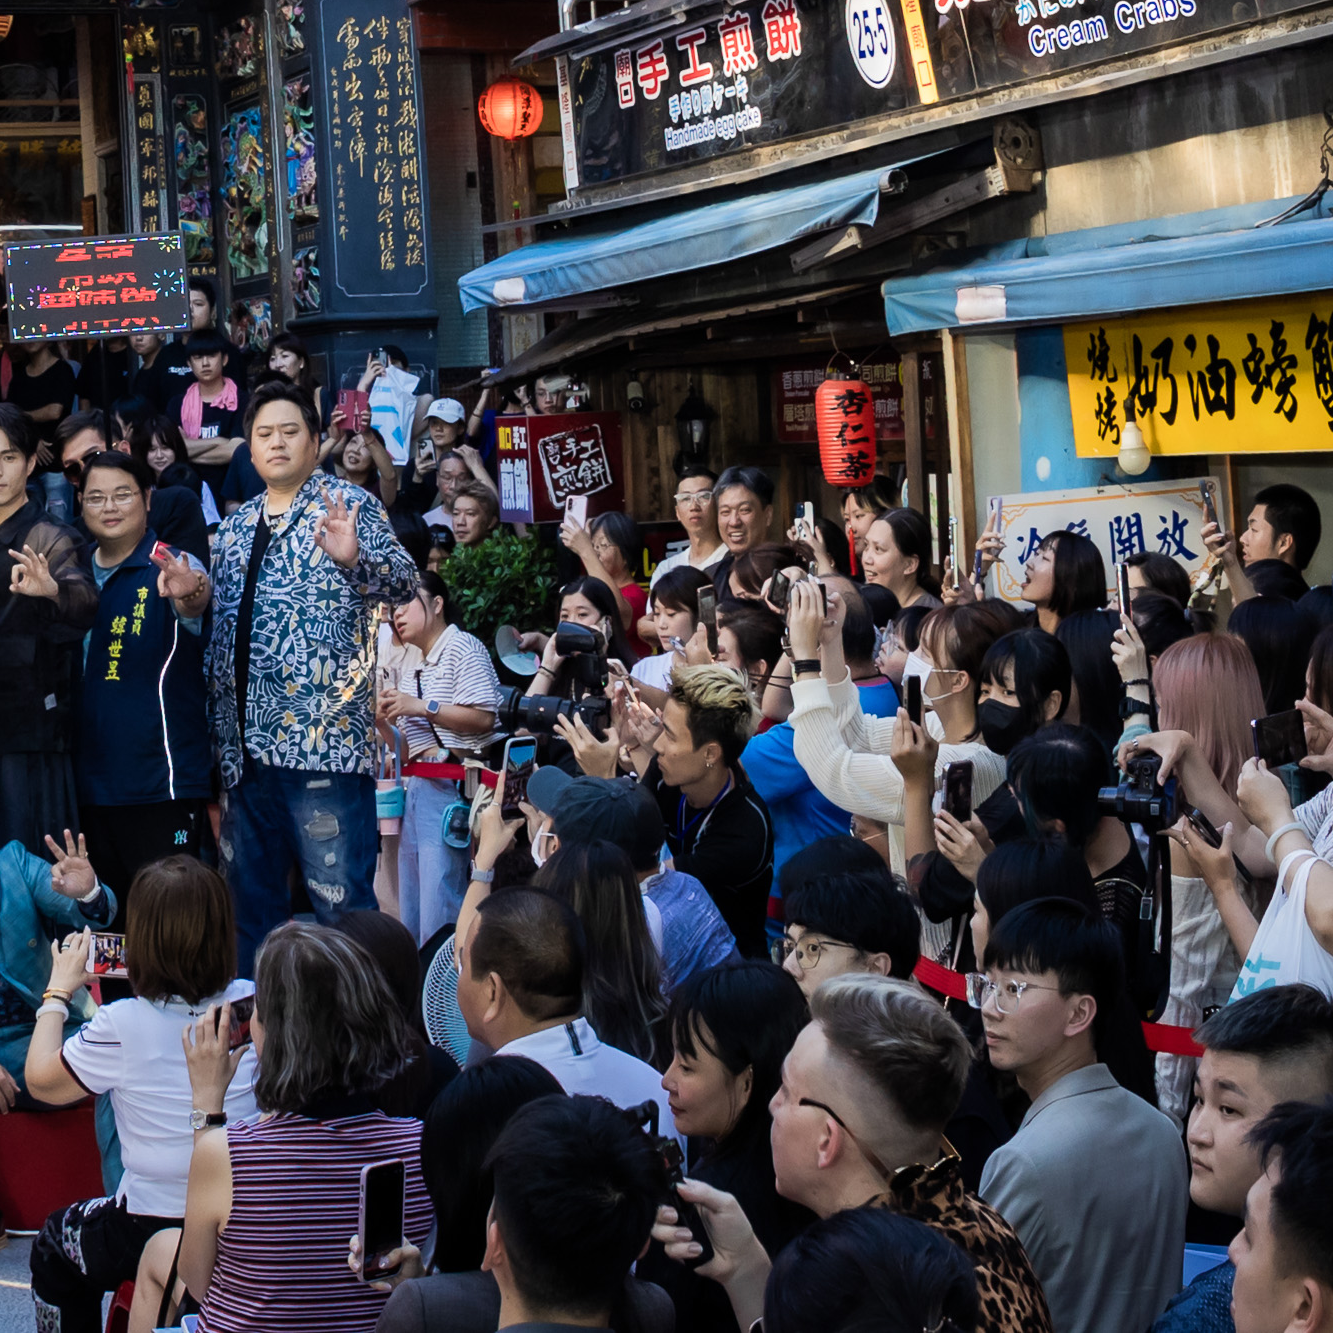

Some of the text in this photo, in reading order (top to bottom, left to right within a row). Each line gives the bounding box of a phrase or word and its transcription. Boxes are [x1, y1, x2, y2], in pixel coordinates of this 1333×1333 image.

[1027, 15, 1108, 57] Cream
[615, 48, 636, 109] 廟口
[668, 74, 749, 124] 手作り卵ケーキ
[664, 104, 763, 152] Handmade egg cake
[1087, 326, 1121, 446] 燒烤
[832, 389, 872, 481] 杏仁茶
[499, 458, 529, 513] 煎餅
[551, 461, 605, 493] 煎餅
[132, 586, 149, 636] 市議員
